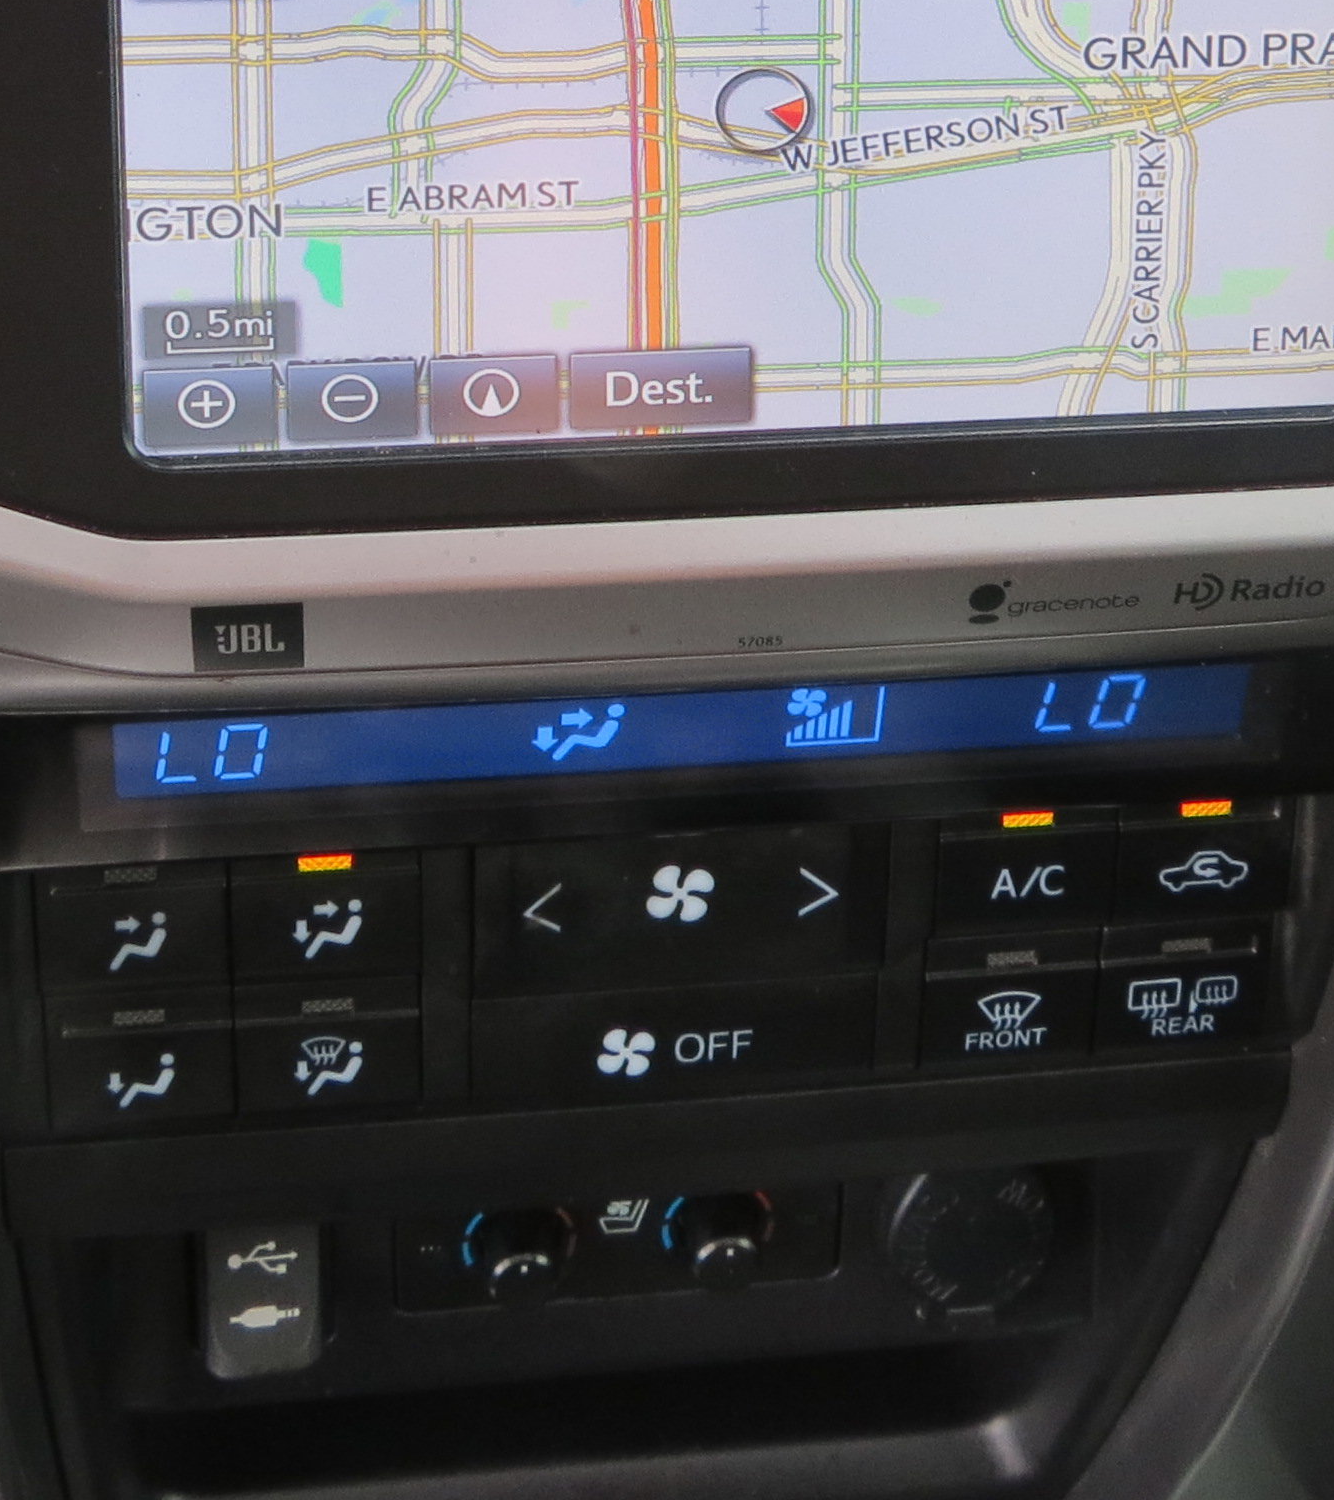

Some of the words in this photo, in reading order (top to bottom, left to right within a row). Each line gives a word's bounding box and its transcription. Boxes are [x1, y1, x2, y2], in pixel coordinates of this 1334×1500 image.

[1083, 33, 1247, 71] GRAND
[780, 144, 815, 174] W
[827, 107, 1020, 169] JEFFERSON
[1030, 105, 1069, 135] ST
[1136, 129, 1169, 189] PKY
[367, 187, 388, 214] E
[397, 182, 528, 212] ABRAM
[539, 180, 580, 208] ST
[128, 203, 284, 243] GTON
[1134, 198, 1165, 321] CARRIER
[165, 308, 275, 341] 0.5mi
[1132, 331, 1159, 349] S
[1252, 326, 1270, 352] E
[605, 370, 714, 408] Dest.
[1007, 592, 1140, 619] gracenote
[1229, 576, 1326, 603] Radio
[214, 623, 286, 656] JBL
[990, 864, 1066, 900] A/C
[964, 1026, 1048, 1051] FRONT
[1151, 1013, 1215, 1037] REAR
[674, 1029, 754, 1064] OFF
